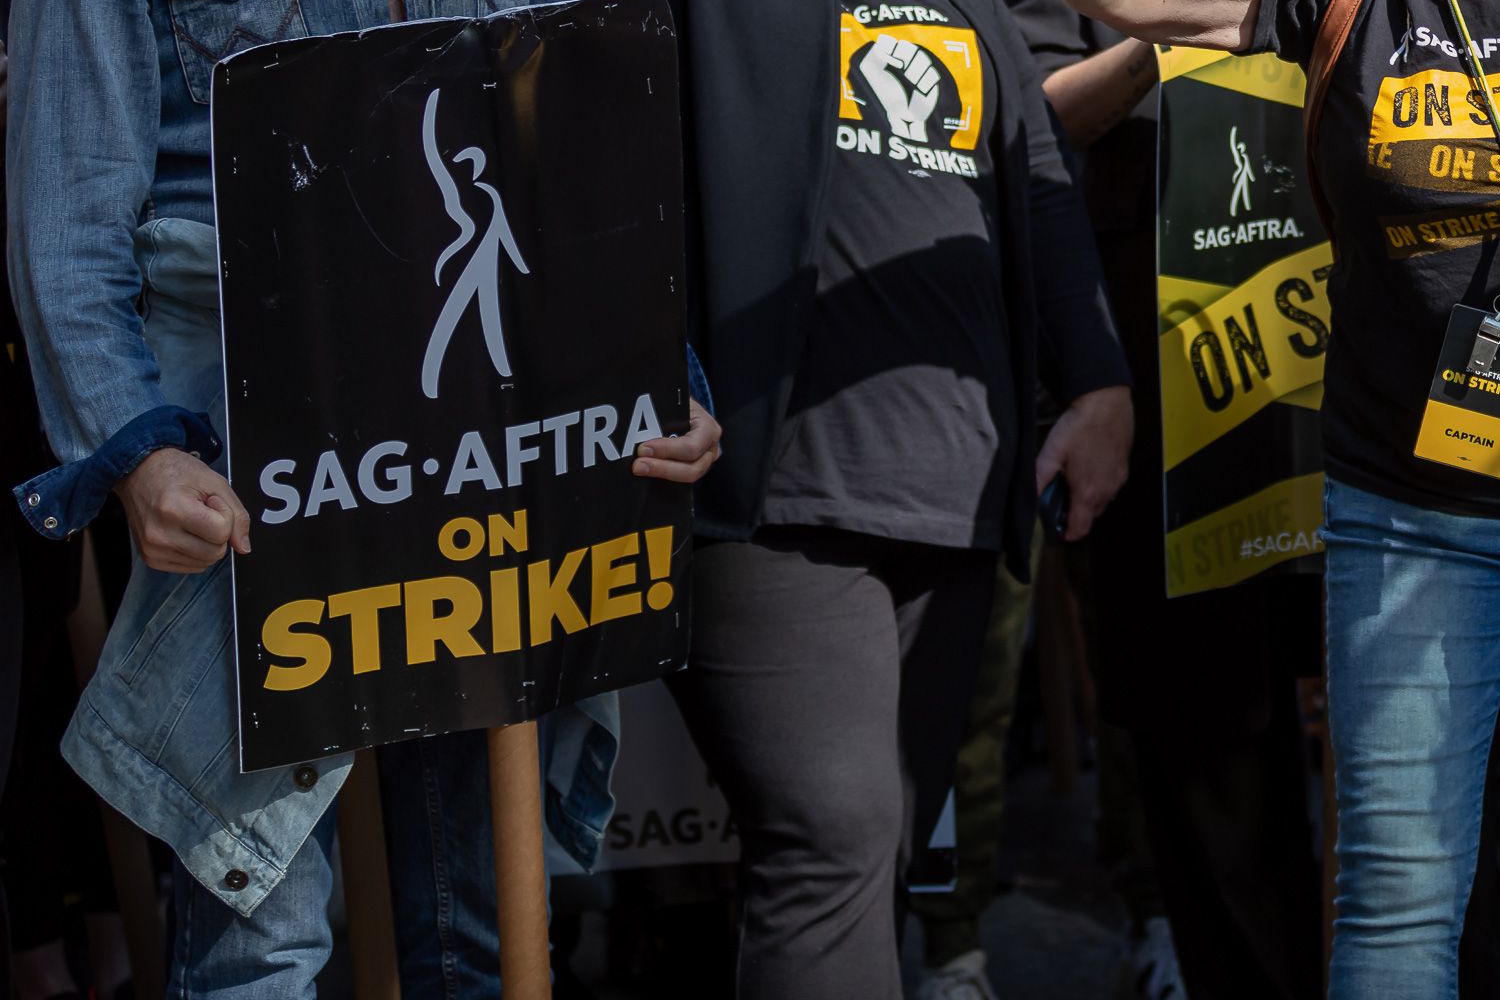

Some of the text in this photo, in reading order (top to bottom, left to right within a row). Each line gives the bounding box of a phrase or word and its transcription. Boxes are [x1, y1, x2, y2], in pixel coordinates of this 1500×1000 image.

[1392, 83, 1453, 129] ON
[836, 125, 979, 179] ON STRIKE!
[1428, 144, 1475, 181] ON
[1385, 223, 1418, 250] ON
[1190, 303, 1273, 414] ON
[1442, 369, 1466, 385] ON
[1444, 428, 1494, 449] CAPTAIN
[437, 509, 528, 562] ON
[261, 525, 676, 692] STRIKE!
